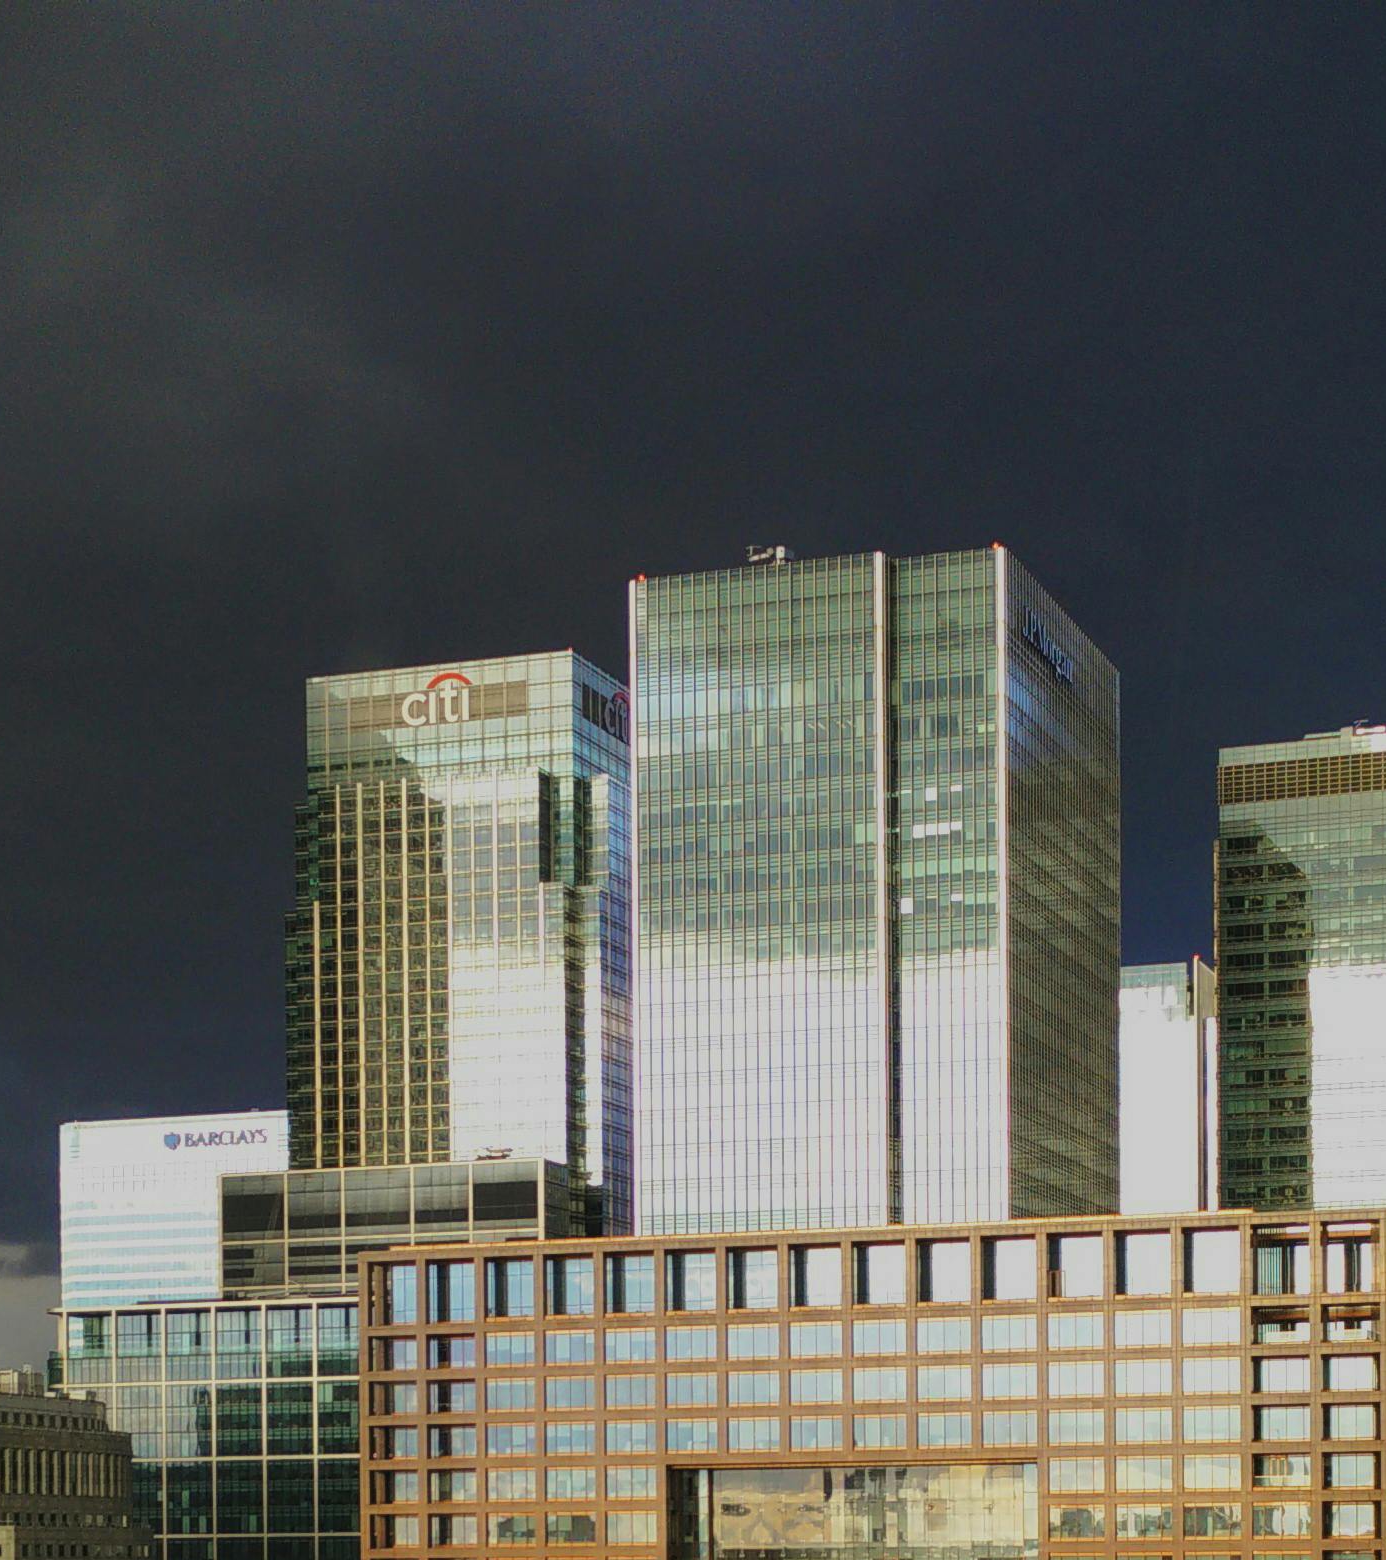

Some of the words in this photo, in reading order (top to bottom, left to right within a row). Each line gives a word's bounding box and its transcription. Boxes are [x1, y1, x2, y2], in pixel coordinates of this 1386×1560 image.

[401, 681, 470, 727] citi
[604, 700, 629, 744] cit
[184, 1128, 268, 1147] BARCLAYS
